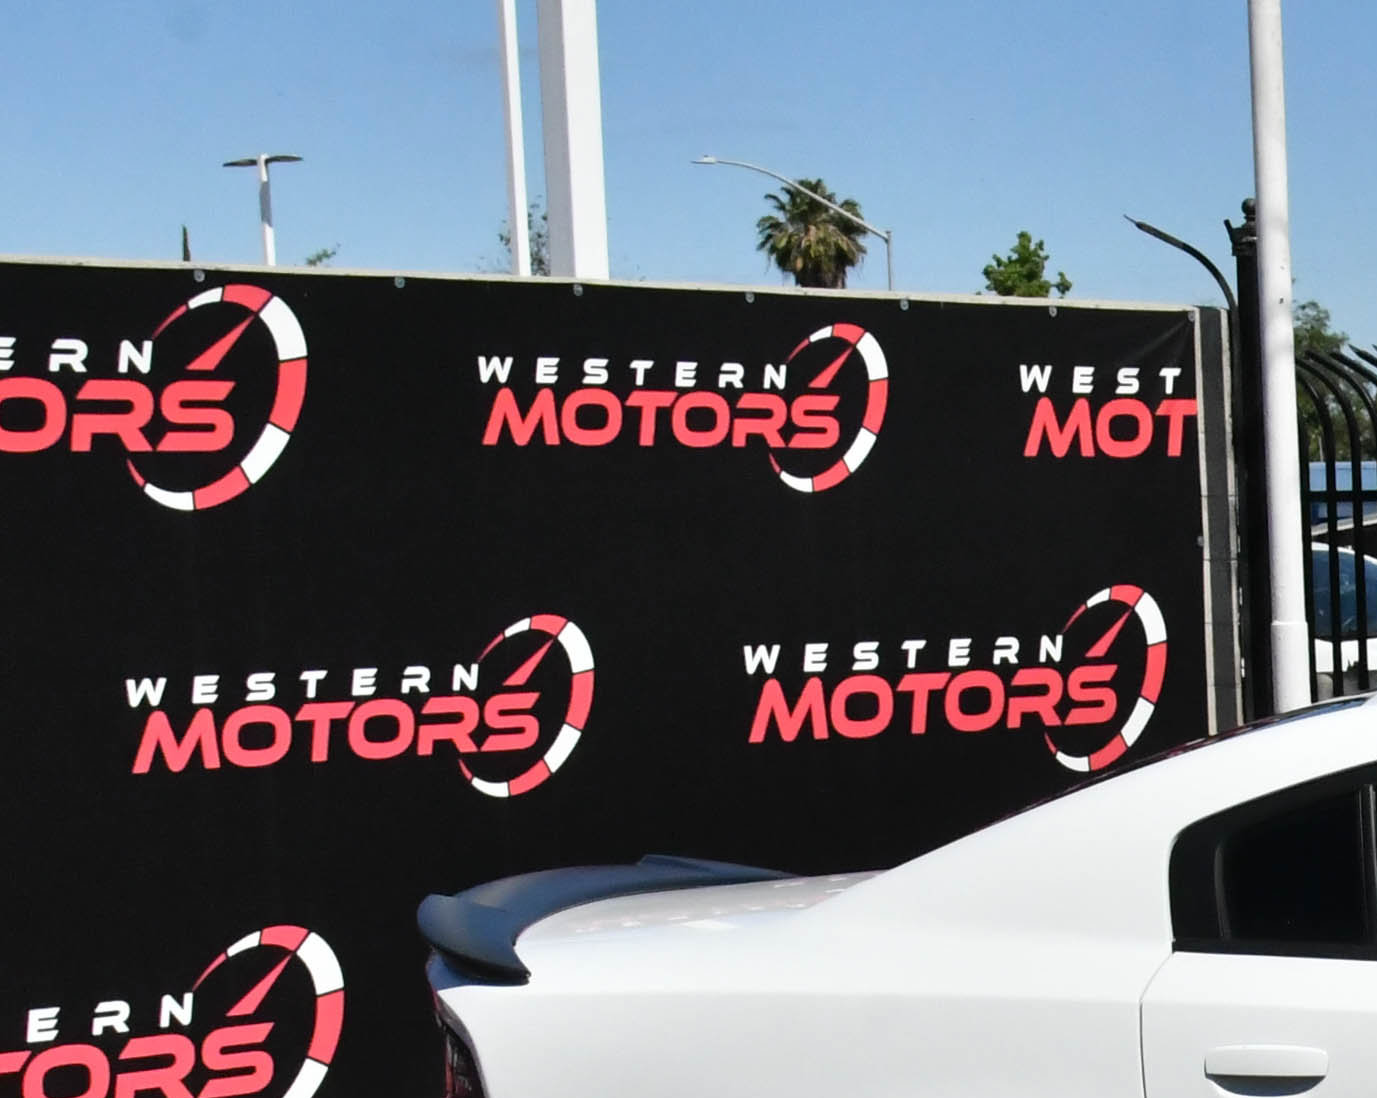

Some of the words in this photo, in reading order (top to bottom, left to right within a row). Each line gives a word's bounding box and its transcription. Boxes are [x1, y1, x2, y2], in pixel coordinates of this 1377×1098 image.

[477, 355, 787, 389] WESTERN
[1019, 364, 1182, 394] WEST
[0, 376, 236, 453] ORS
[482, 387, 841, 449] MOTORS
[1023, 396, 1199, 459] MOT
[743, 634, 1064, 675] WESTERN
[125, 663, 479, 708] WESTERN
[748, 663, 1118, 744] MOTORS
[131, 691, 540, 774] MOTORS
[26, 992, 194, 1044] ERN
